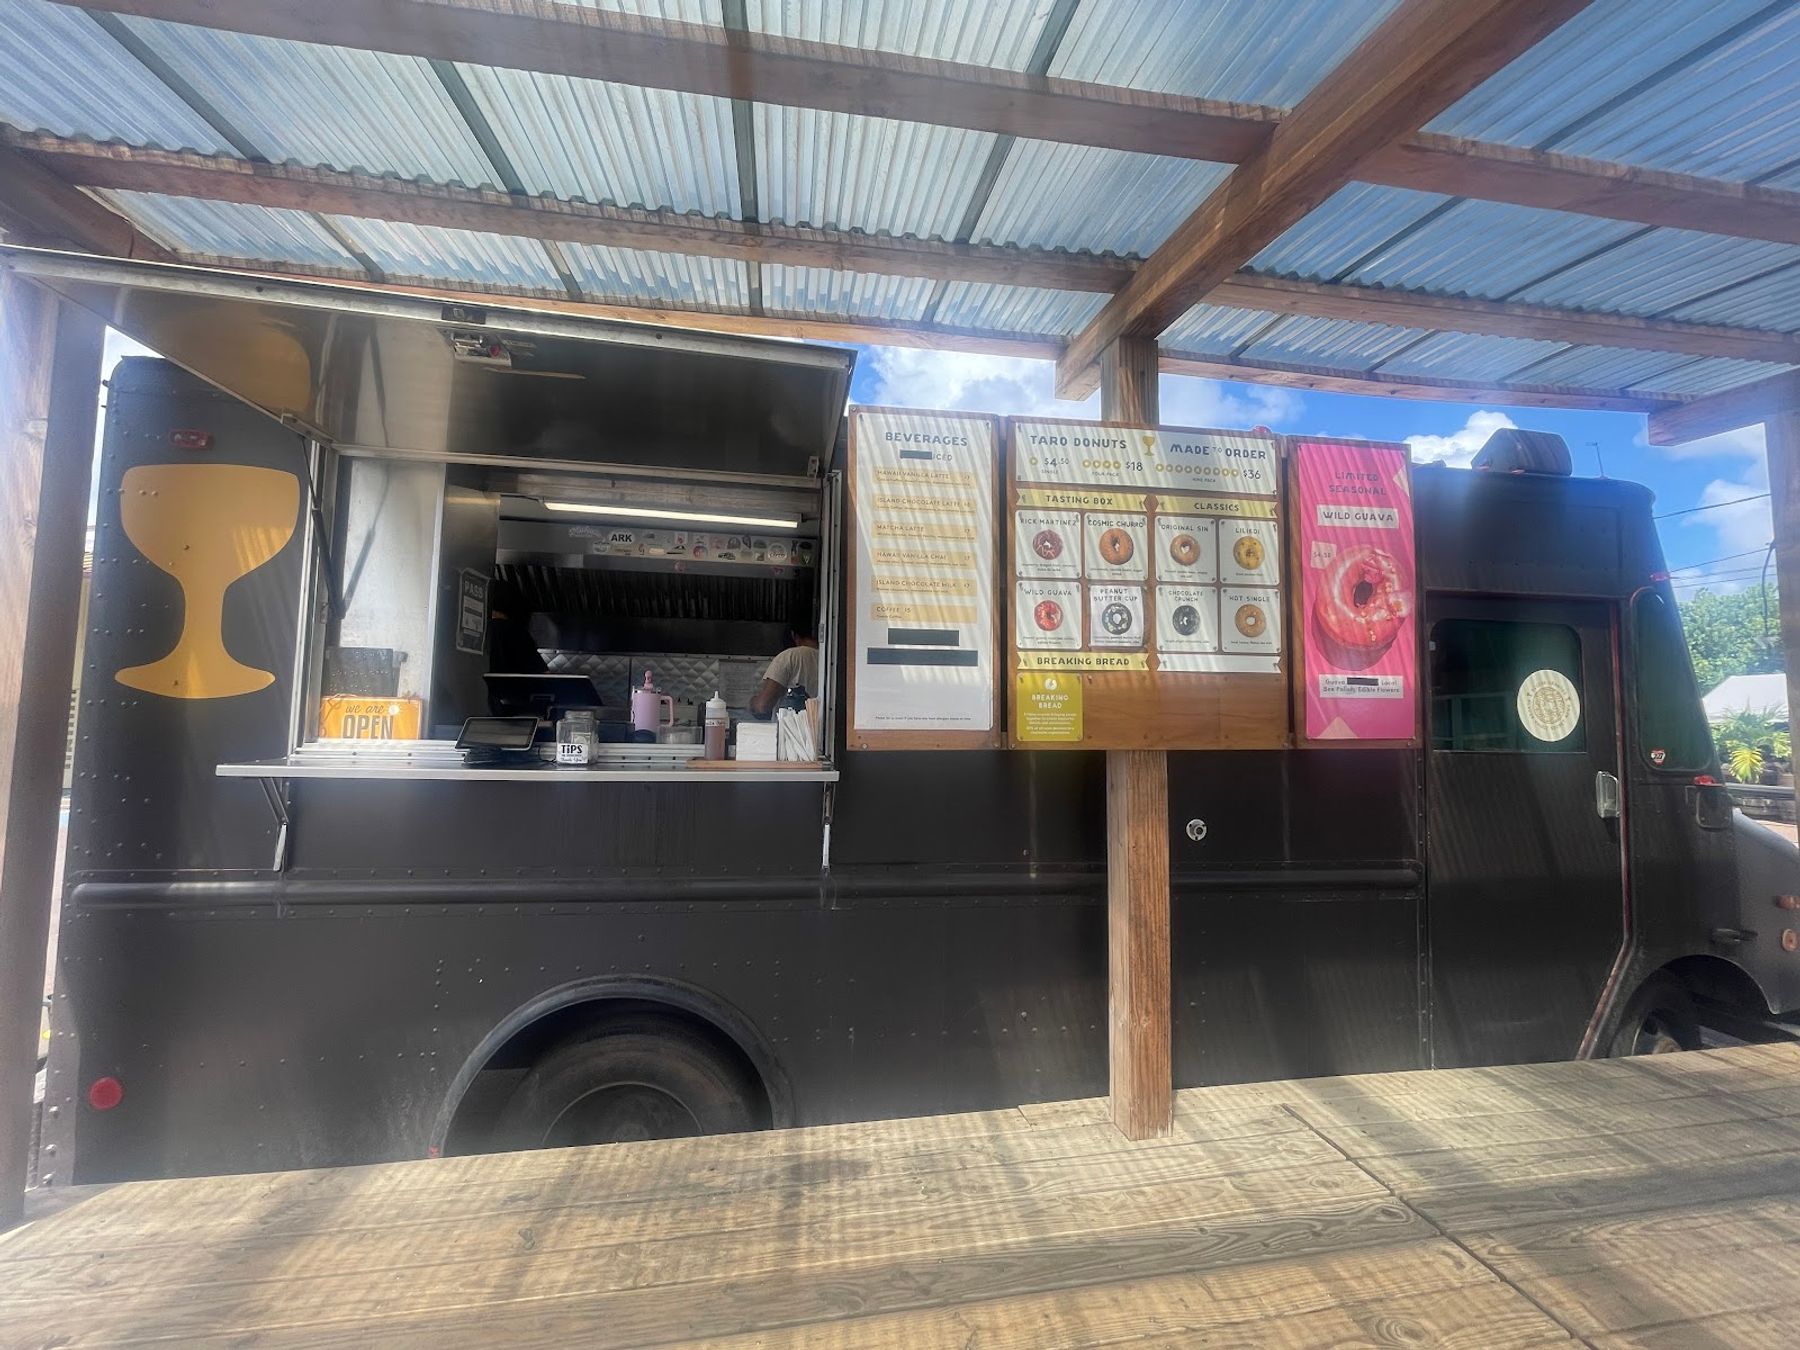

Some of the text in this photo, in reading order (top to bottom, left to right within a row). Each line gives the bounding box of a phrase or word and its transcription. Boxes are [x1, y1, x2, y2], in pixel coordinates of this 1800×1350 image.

[885, 431, 969, 447] BEVERAGES
[1030, 435, 1068, 447] TARO
[1073, 437, 1127, 449] DONUTS
[1170, 443, 1210, 456] MADE
[1224, 447, 1266, 460] ORDER
[1126, 461, 1143, 472] $18
[1243, 469, 1261, 480] $36
[1335, 471, 1379, 482] LIMITED
[1329, 484, 1387, 496] SEASONAL
[1045, 494, 1113, 506] TASTING BOX
[1193, 502, 1240, 512] CLASSICS
[1322, 511, 1394, 522] WILD GUAVA
[1087, 519, 1114, 527] COSMIC
[611, 533, 633, 543] ARK
[464, 580, 483, 599] PASS
[1024, 588, 1044, 596] WILD
[1037, 656, 1130, 666] BREAKING BREAD
[1031, 693, 1070, 701] BREAKING
[345, 704, 384, 714] we are
[1038, 701, 1062, 709] BREAD
[342, 714, 394, 740] OPEN
